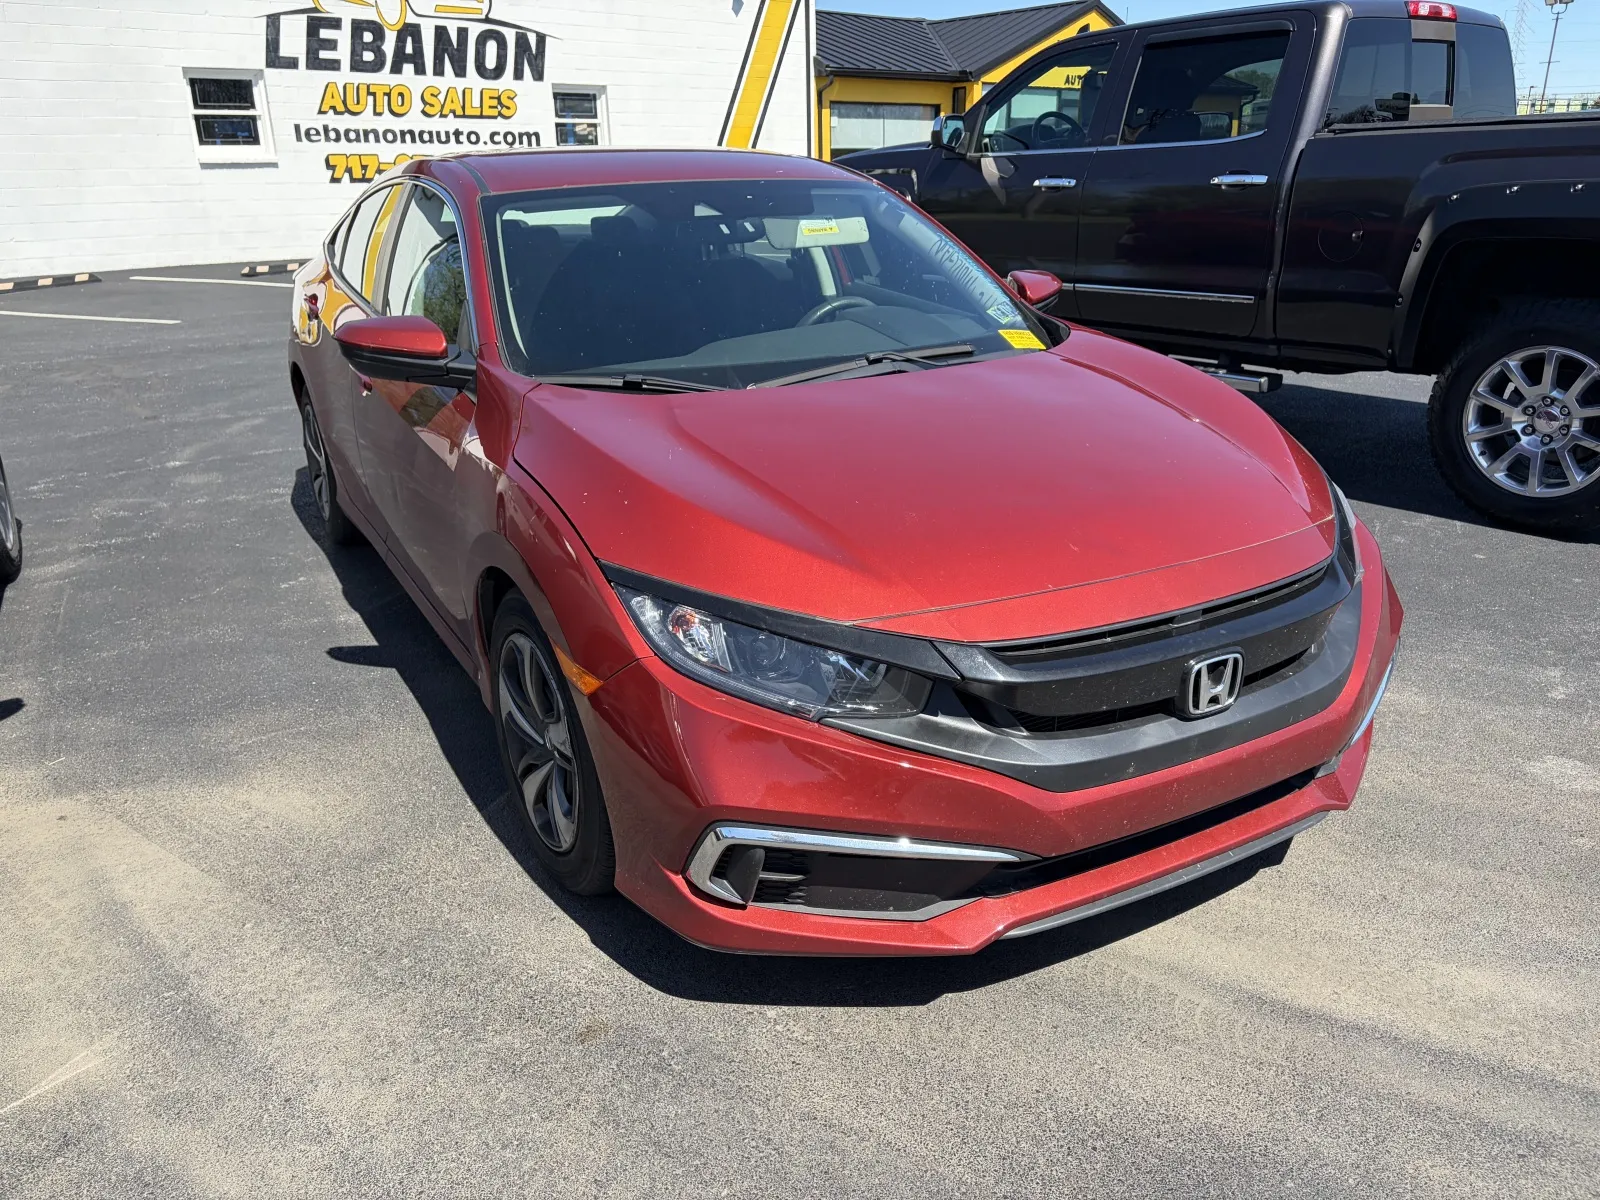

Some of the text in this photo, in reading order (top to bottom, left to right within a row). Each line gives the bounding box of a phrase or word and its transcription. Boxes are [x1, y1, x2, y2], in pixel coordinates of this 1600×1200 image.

[265, 14, 547, 82] LEBANON
[317, 82, 518, 120] AUTO SALES
[294, 123, 541, 148] lebanonauto.com
